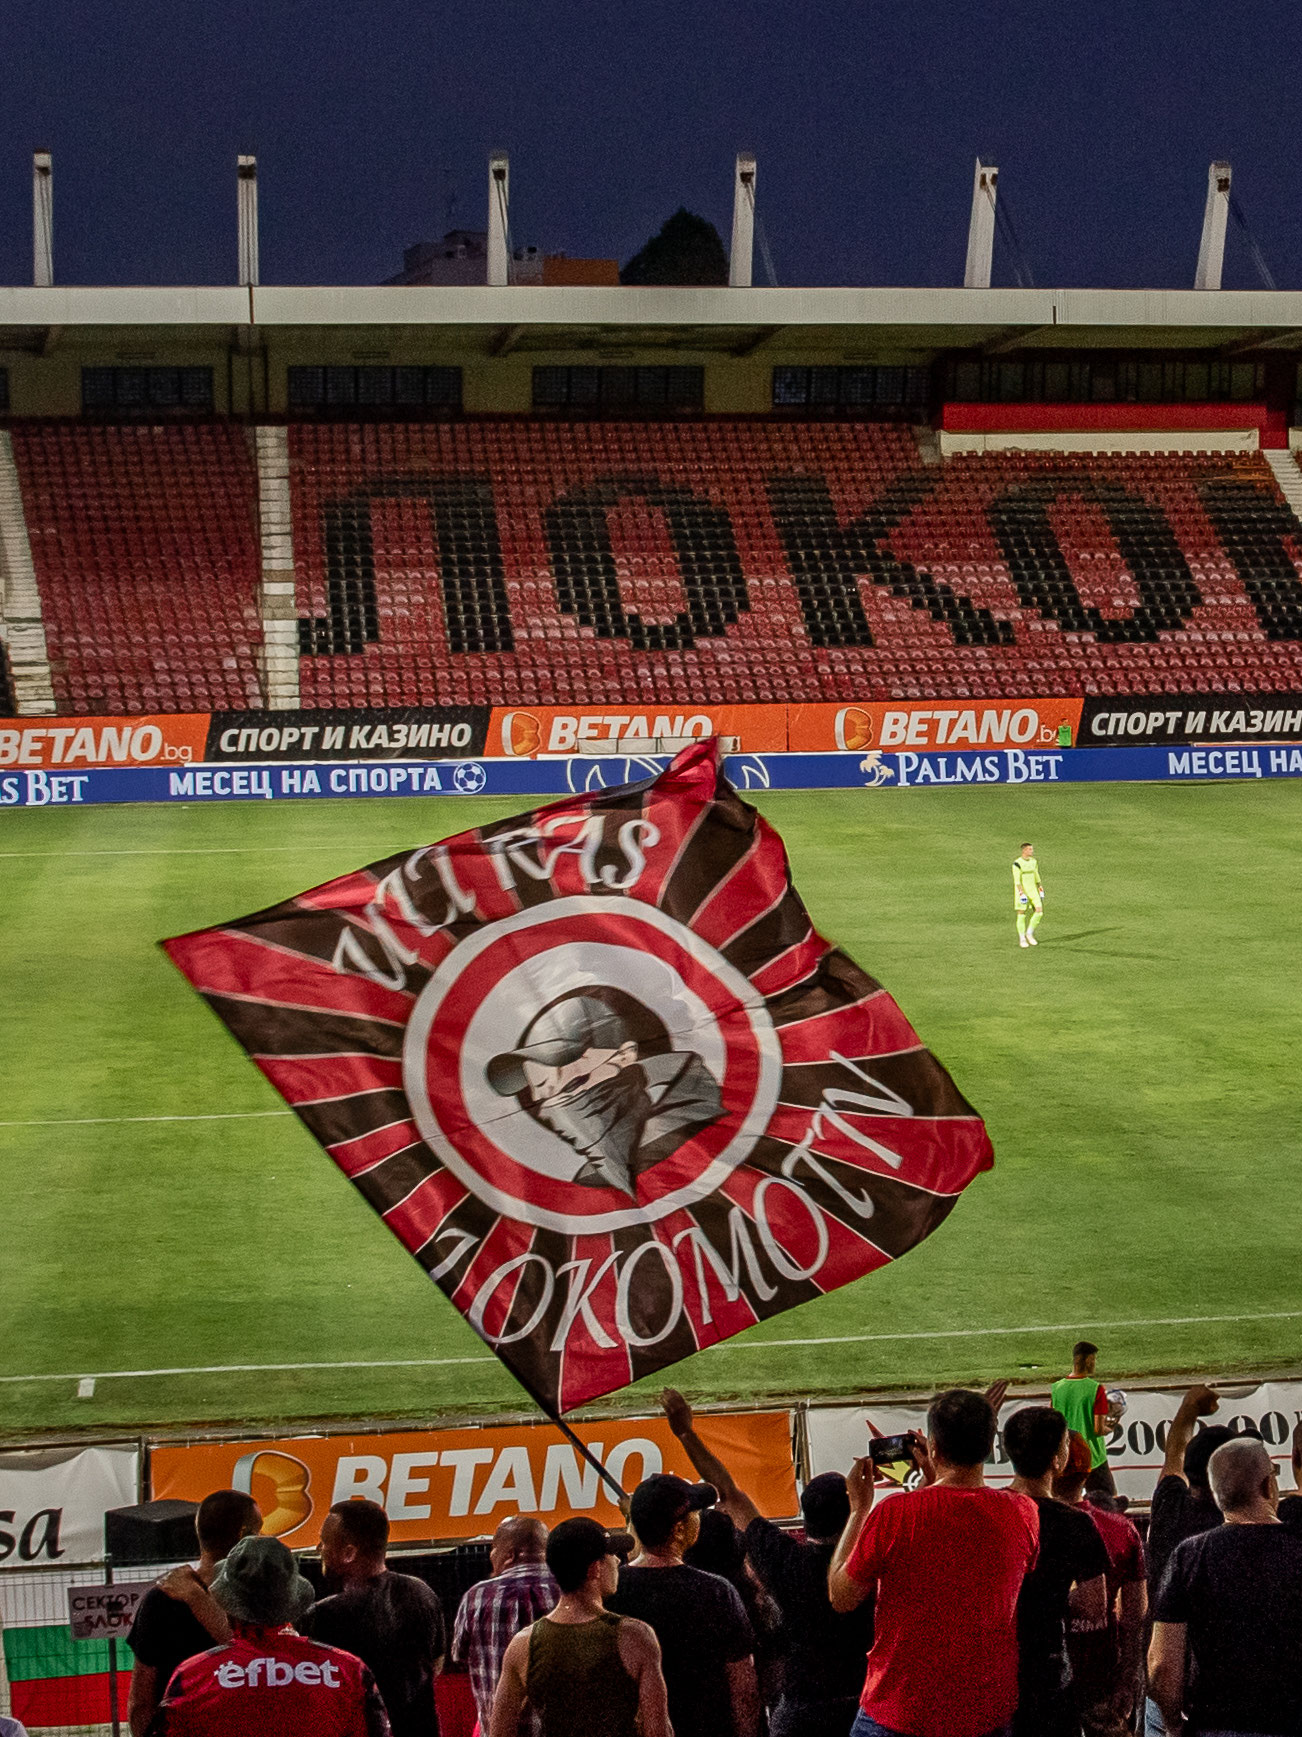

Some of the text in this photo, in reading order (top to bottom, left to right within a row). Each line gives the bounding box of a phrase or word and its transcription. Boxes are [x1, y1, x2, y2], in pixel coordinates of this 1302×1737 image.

[219, 723, 473, 752] СПОРТ И КАЗИНО
[548, 714, 713, 751] BETANO
[1091, 711, 1182, 736] СПОРТ
[1184, 711, 1206, 734] И
[1168, 751, 1262, 778] МЕСЕЦ
[24, 770, 89, 805] BET
[169, 767, 443, 799] МЕСЕЦ НА СПОРТА
[332, 1438, 663, 1522] BETANO
[72, 1593, 140, 1611] СЕКТОР
[214, 1657, 340, 1688] efbet
